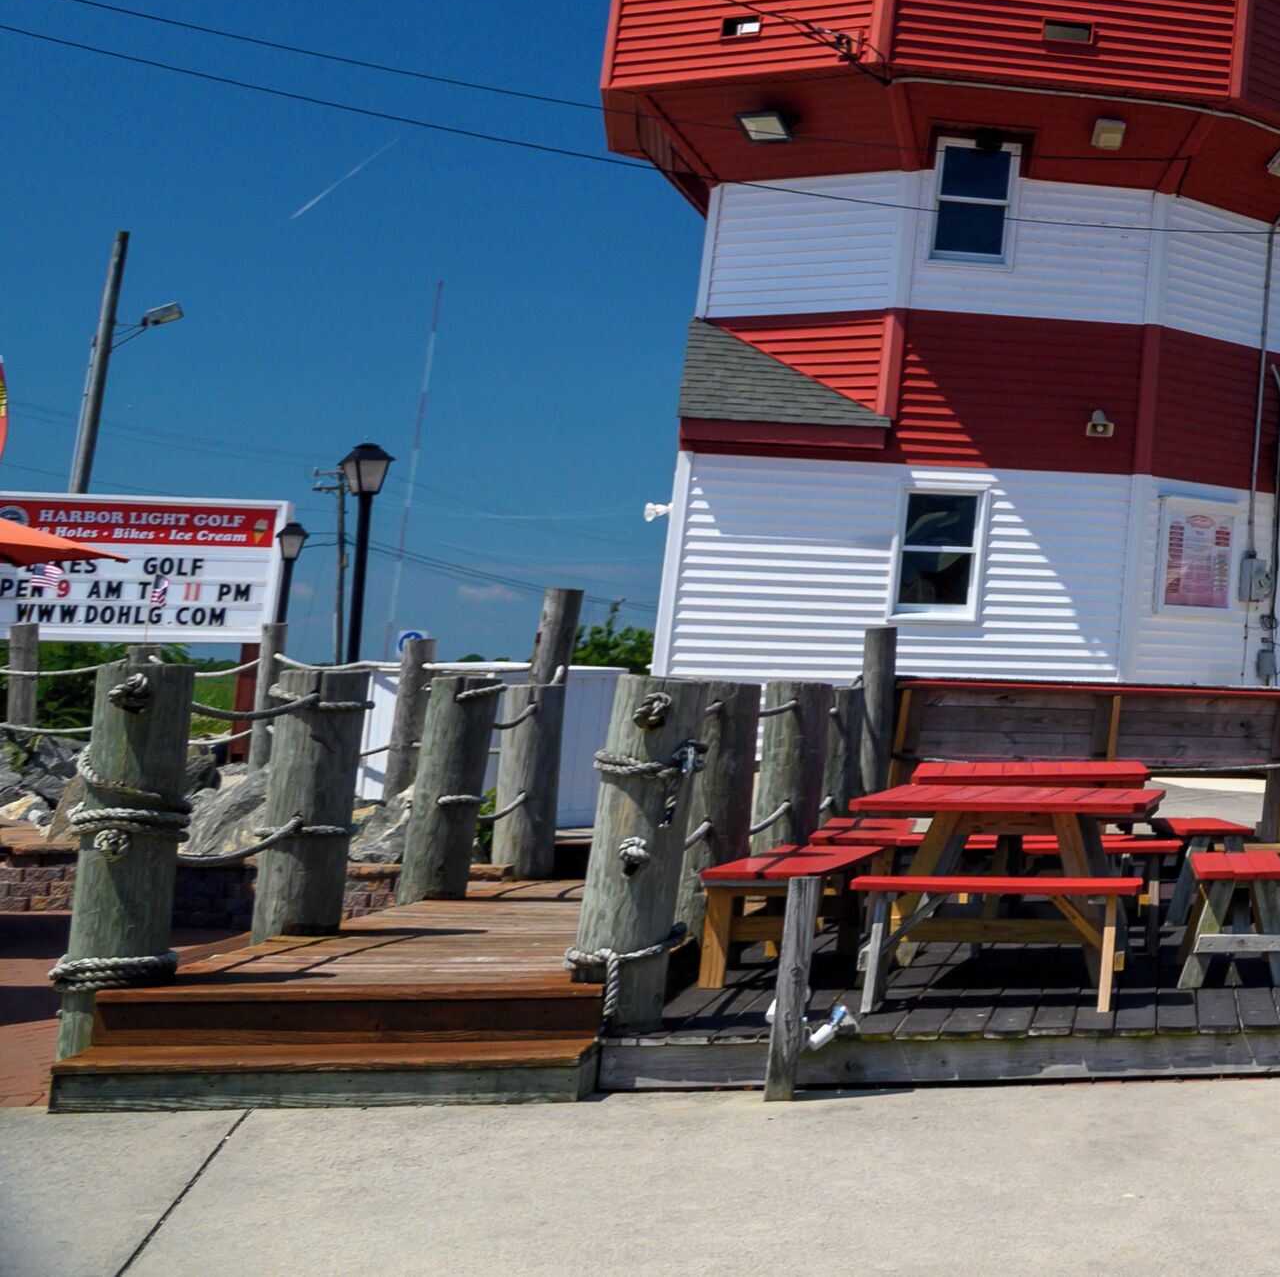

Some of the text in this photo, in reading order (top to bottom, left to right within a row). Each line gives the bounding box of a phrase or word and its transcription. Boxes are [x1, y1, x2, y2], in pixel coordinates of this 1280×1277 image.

[38, 509, 246, 528] HARBOR LIGHT GOLF
[54, 526, 98, 538] Holes
[112, 527, 156, 540] Bikes
[168, 529, 193, 541] Ice
[196, 530, 247, 543] Cream
[143, 557, 205, 576] GOLF
[56, 580, 71, 598] 9
[87, 581, 123, 599] AM
[217, 584, 251, 602] PM
